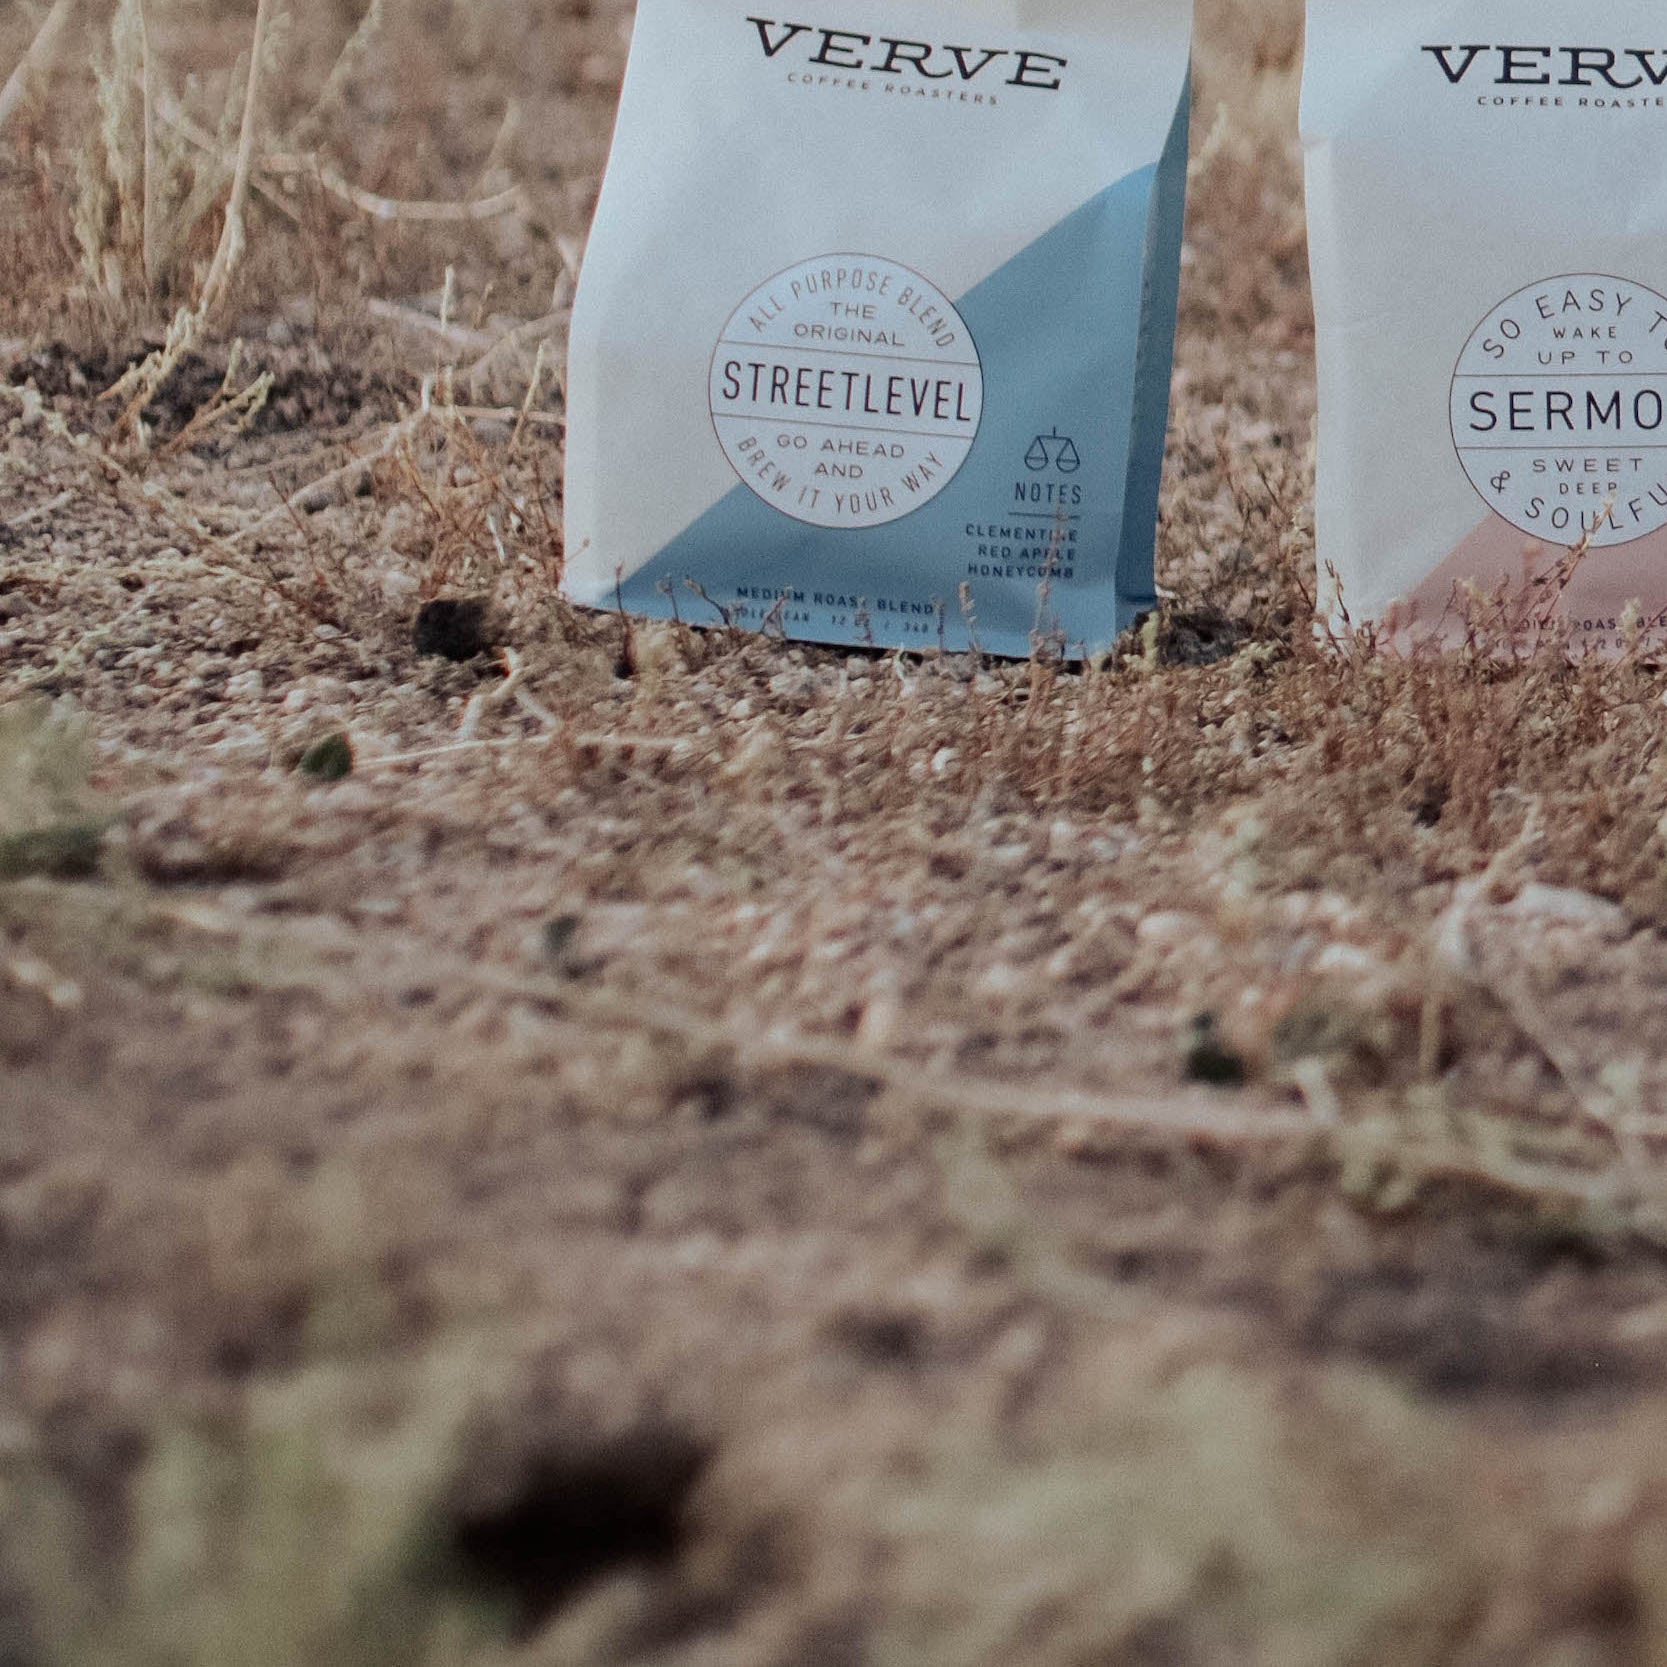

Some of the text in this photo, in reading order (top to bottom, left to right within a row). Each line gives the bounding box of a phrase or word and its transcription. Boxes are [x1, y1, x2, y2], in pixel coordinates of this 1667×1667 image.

[746, 16, 1067, 90] VERVE
[787, 73, 997, 105] COFFEE ROASTERS
[1478, 96, 1563, 107] COFFEE
[749, 269, 955, 348] ALL PURPOSE BLEND
[830, 301, 877, 319] THE
[794, 324, 905, 346] ORIGINAL
[1483, 319, 1521, 359] SO
[1535, 289, 1632, 319] EASY
[1554, 327, 1616, 339] WAKE
[1538, 350, 1632, 364] UP TO
[722, 361, 971, 421] STREETLEVEL
[777, 434, 904, 458] GO AHEAD
[737, 436, 944, 514] BREW IT YOUR WAY
[814, 462, 863, 478] AND
[1533, 459, 1642, 472] SWEET
[1015, 482, 1081, 504] NOTES
[1490, 470, 1510, 494] &
[1560, 483, 1616, 494] DEEP
[979, 545, 1011, 558] RED
[814, 593, 866, 609] ROAS
[877, 598, 934, 615] BLEND
